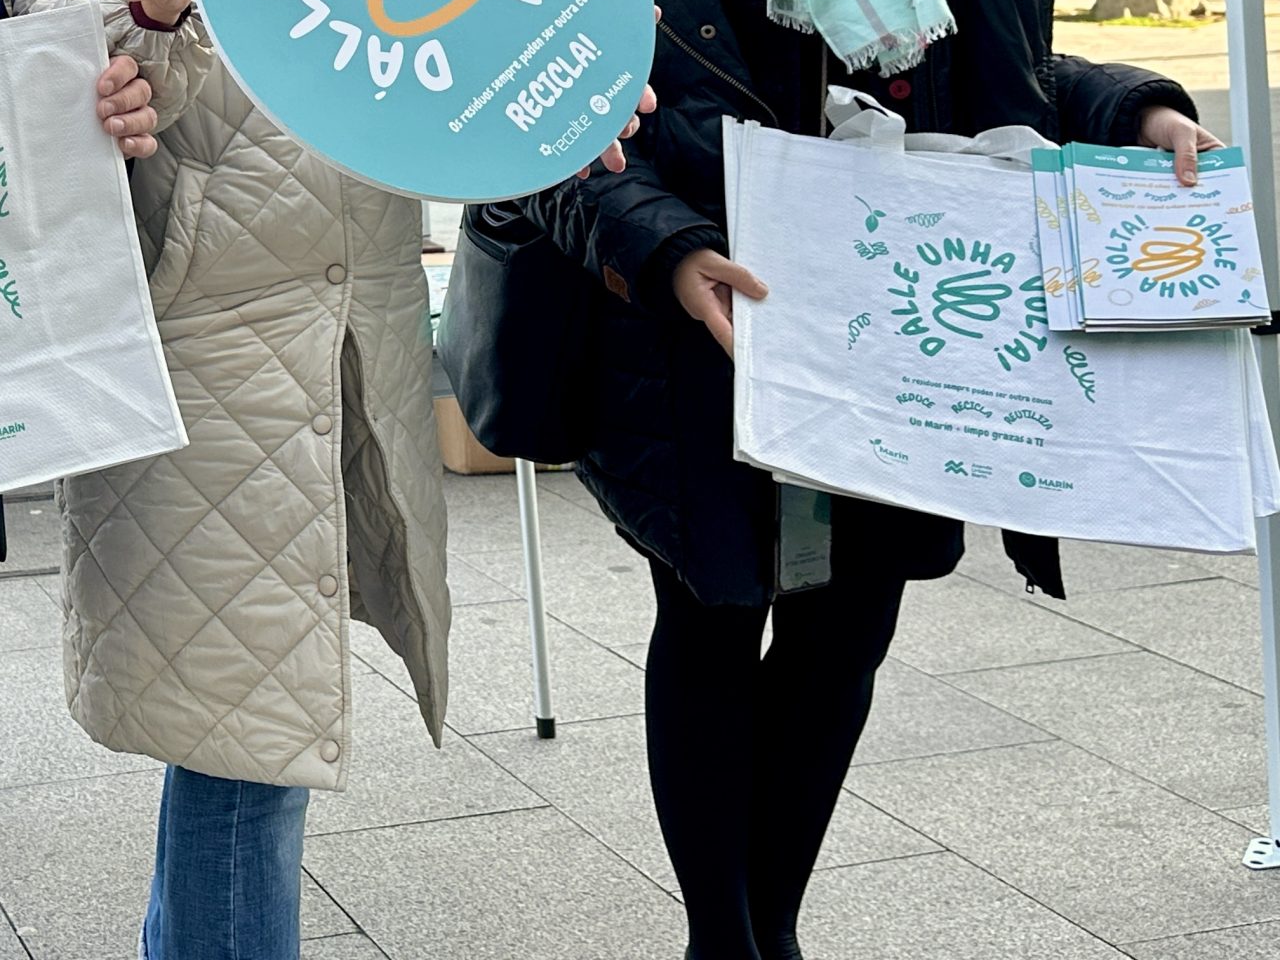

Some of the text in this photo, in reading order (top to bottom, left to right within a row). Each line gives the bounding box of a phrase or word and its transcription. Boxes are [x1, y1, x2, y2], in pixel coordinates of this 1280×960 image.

[448, 118, 462, 132] Os
[461, 87, 494, 123] residuos
[491, 61, 521, 91] sempre
[520, 38, 544, 66] poden
[541, 25, 555, 41] ser
[555, 4, 579, 28] outra
[506, 33, 602, 132] RECICLA!
[605, 71, 632, 100] MARÍN
[551, 114, 592, 156] recolte
[1105, 214, 1149, 279] VOLTA!
[1186, 214, 1238, 270] DÁLLE
[888, 238, 1048, 371] DÁLLE UNHA VOLTA!
[1139, 274, 1220, 298] UNHA
[895, 393, 1053, 430] REDUCE RECICLA REUTILIZA
[964, 425, 989, 437] limpo
[992, 430, 1024, 444] grazas
[1026, 437, 1032, 445] a
[1033, 437, 1044, 447] TI
